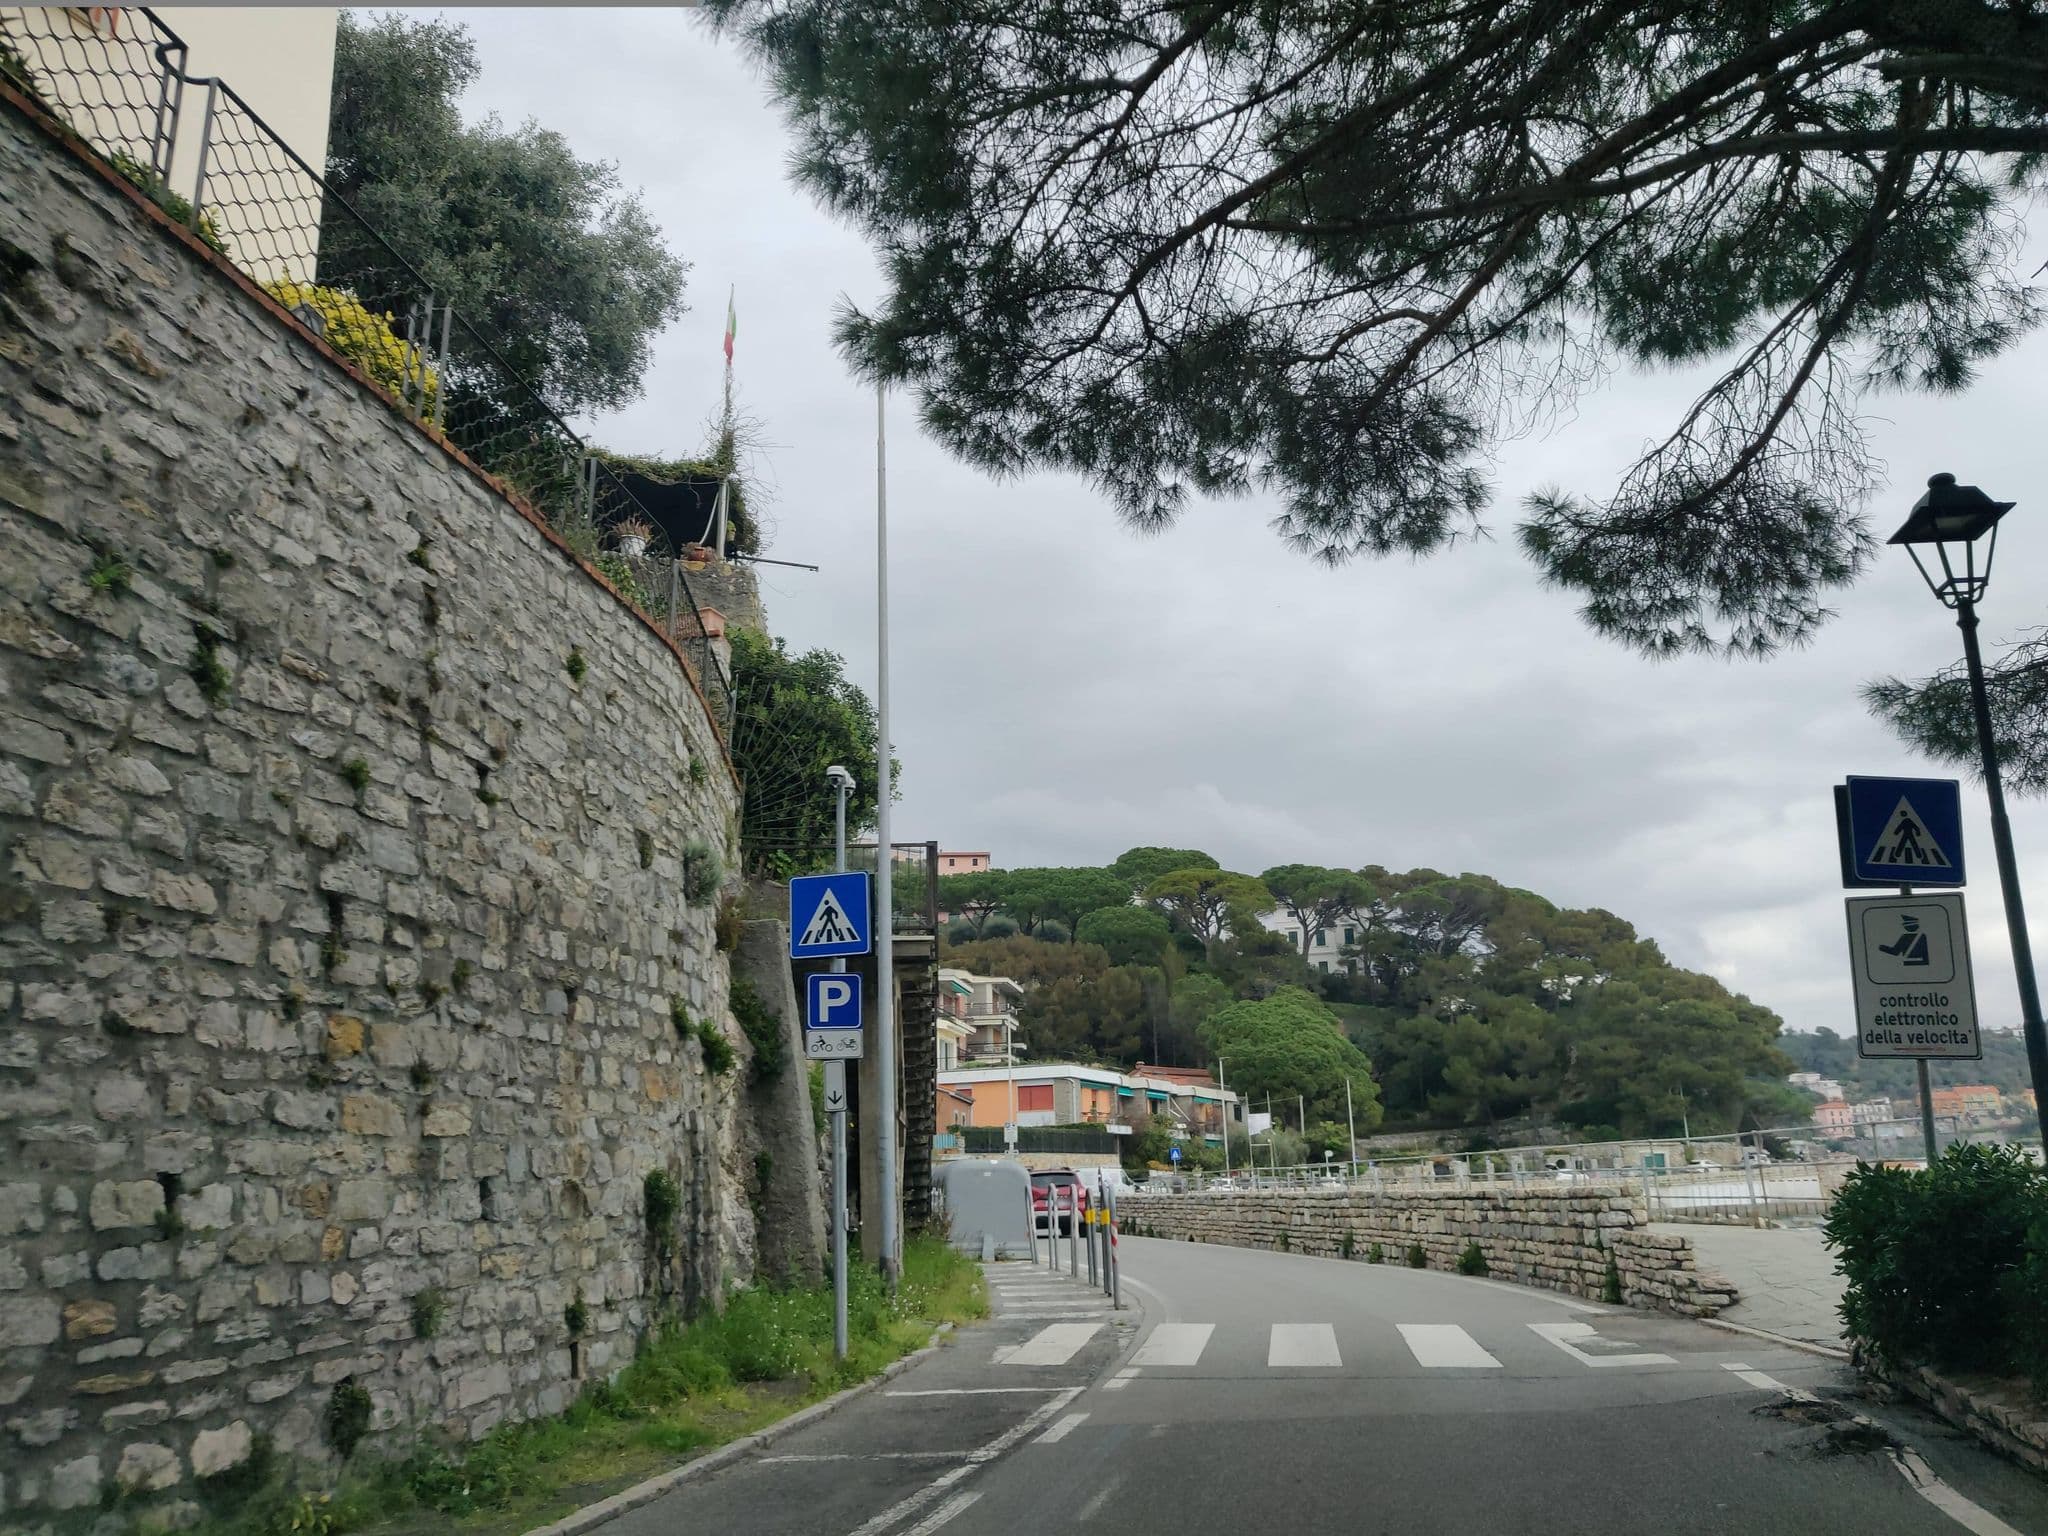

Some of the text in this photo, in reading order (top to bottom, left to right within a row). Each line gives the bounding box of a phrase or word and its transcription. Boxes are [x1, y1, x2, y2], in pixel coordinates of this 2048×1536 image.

[819, 981, 851, 1023] P
[1880, 992, 1949, 1007] controllo
[1875, 1011, 1958, 1026] elettronico
[1866, 1030, 1902, 1044] della
